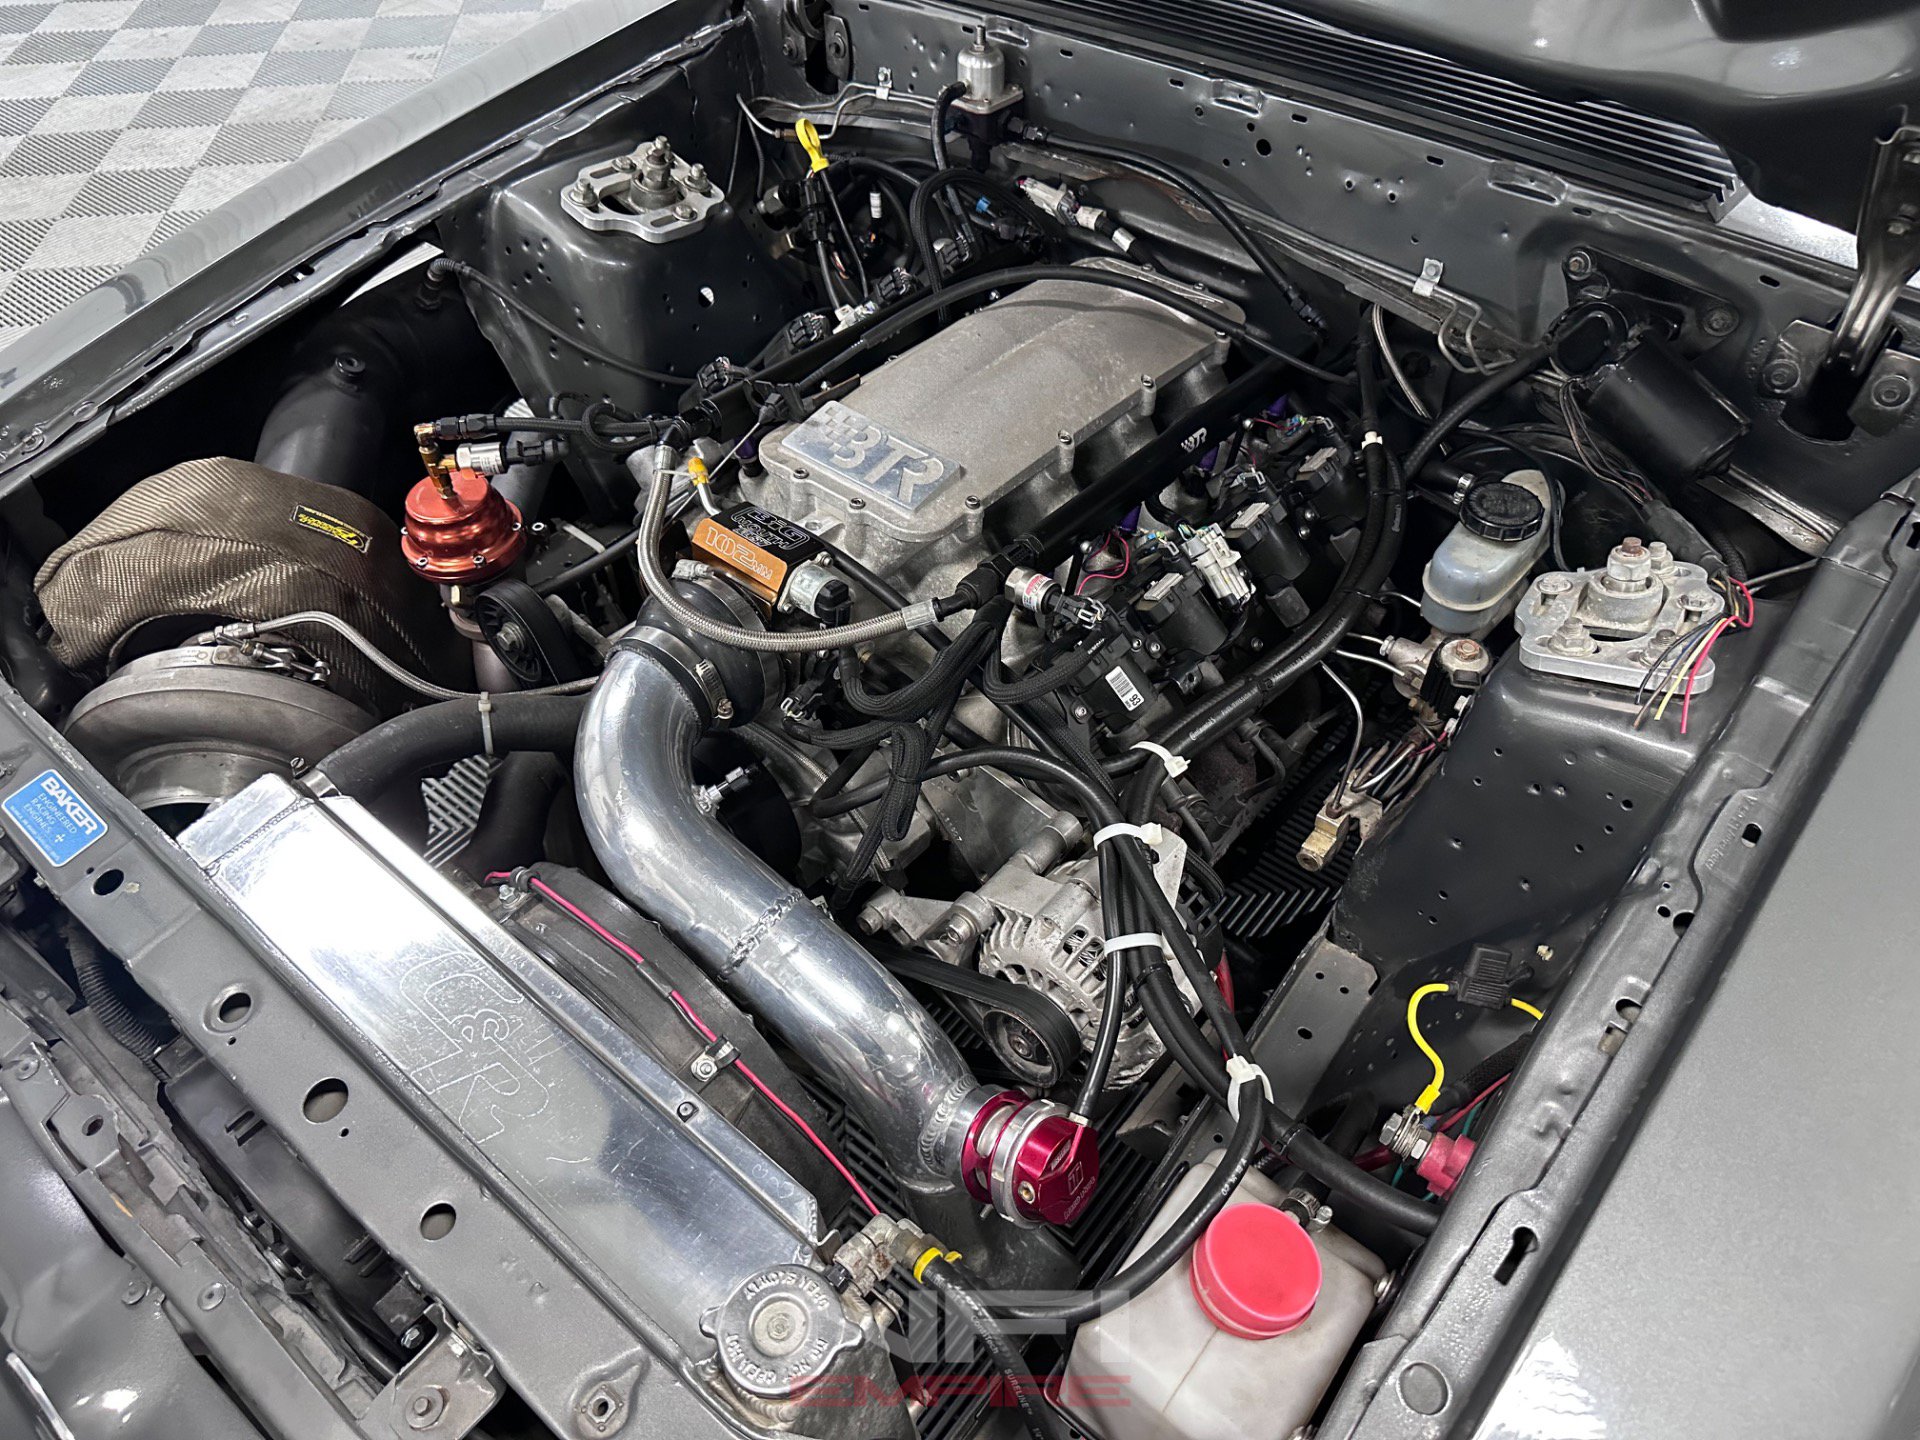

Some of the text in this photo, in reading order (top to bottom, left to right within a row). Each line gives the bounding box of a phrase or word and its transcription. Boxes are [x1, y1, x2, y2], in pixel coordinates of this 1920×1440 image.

[827, 413, 944, 503] BTR
[1129, 692, 1141, 707] 93
[23, 803, 52, 834] ENGINES
[31, 798, 57, 825] RACING
[38, 793, 77, 833] ENGINEERED
[41, 777, 97, 835] BAKER
[400, 952, 549, 1144] C&R
